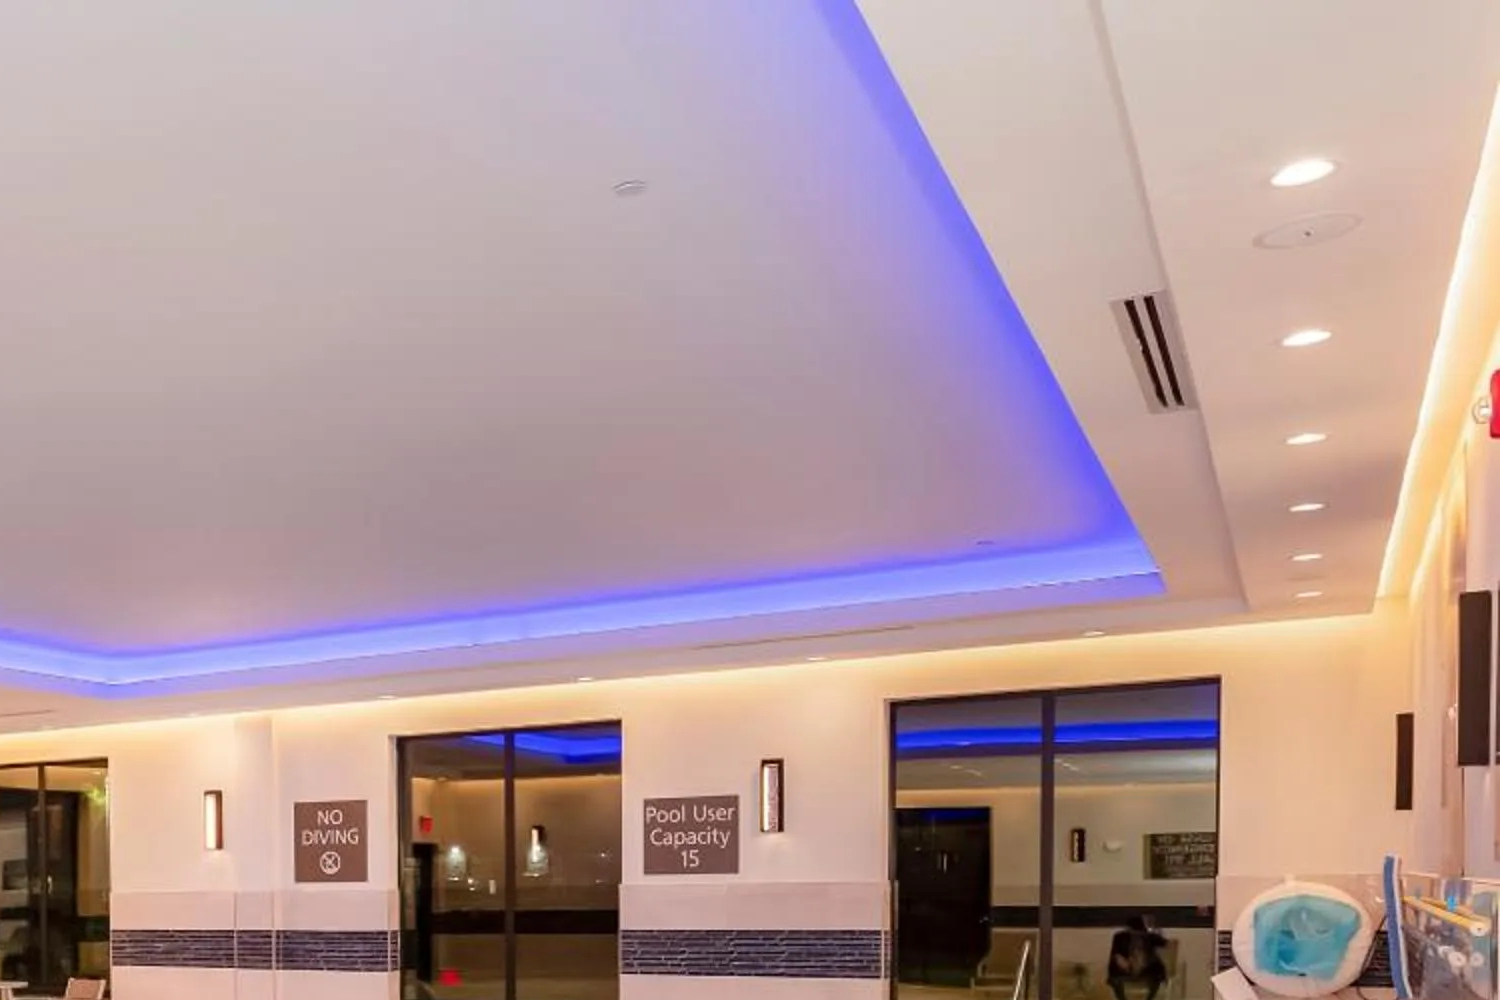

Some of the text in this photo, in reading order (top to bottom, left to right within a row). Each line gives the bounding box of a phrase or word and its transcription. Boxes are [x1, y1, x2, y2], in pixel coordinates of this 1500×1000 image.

[317, 809, 343, 825] NO
[645, 804, 736, 824] Pool User
[301, 827, 359, 845] DIVING
[650, 826, 731, 849] Capacity
[681, 849, 700, 868] 15
